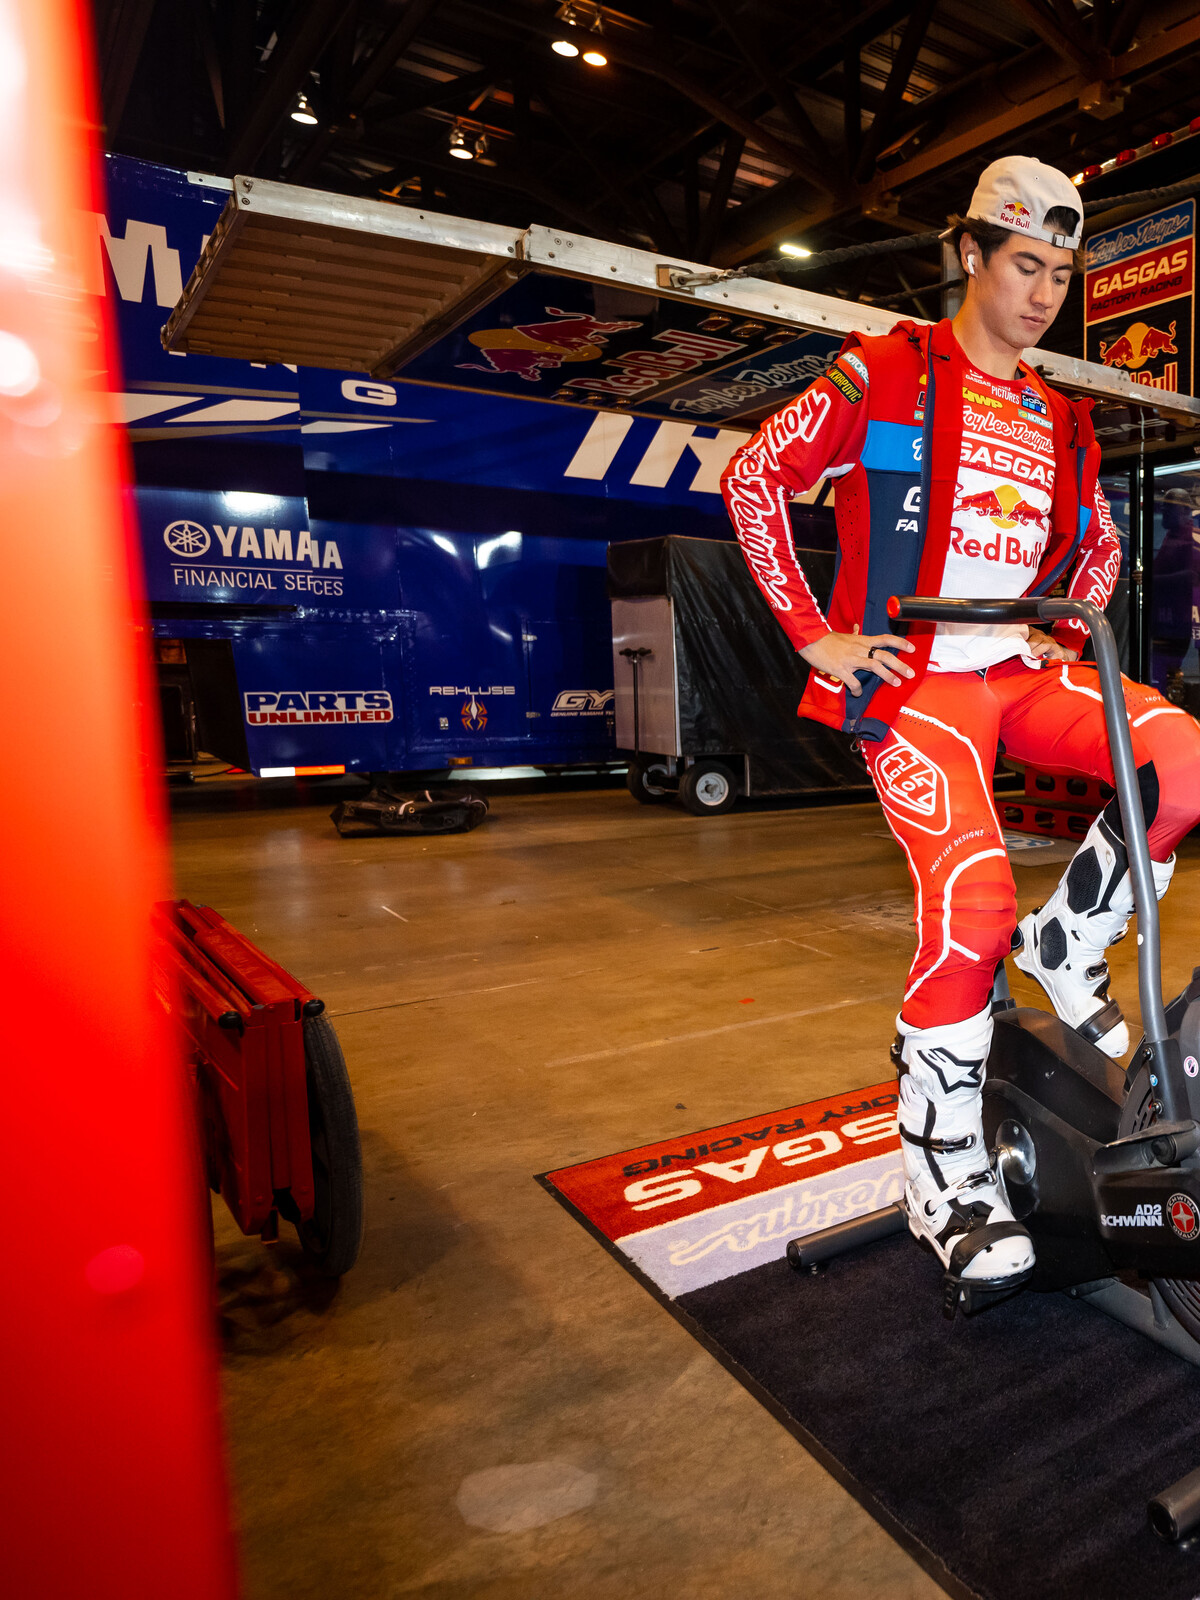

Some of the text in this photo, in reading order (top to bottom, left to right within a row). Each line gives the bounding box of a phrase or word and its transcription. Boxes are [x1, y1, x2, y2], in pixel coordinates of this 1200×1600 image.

[1000, 212, 1031, 230] Red Bull
[1092, 249, 1188, 299] GASGAS
[1090, 275, 1183, 313] FACTORY RACING
[843, 351, 870, 385] MOTORE
[991, 385, 1020, 405] PICTURES
[1021, 395, 1047, 409] GoPro
[984, 411, 1013, 437] Lee
[1011, 420, 1055, 454] Designs
[1095, 418, 1169, 437] GAS
[959, 441, 1056, 490] GASGAS
[952, 527, 1042, 569] Red Bull
[174, 568, 277, 590] FINANCIAL
[244, 690, 393, 712] PARTS
[429, 685, 516, 696] REKLUSE
[247, 709, 393, 725] UNLIMITED
[929, 828, 985, 875] TROY LEE DESIGNS
[621, 1117, 807, 1177] RACING
[624, 1109, 899, 1211] SGAS
[1100, 1214, 1164, 1227] SCHWINN
[1135, 1203, 1162, 1216] AD2
[1172, 1225, 1199, 1239] QUALITY
